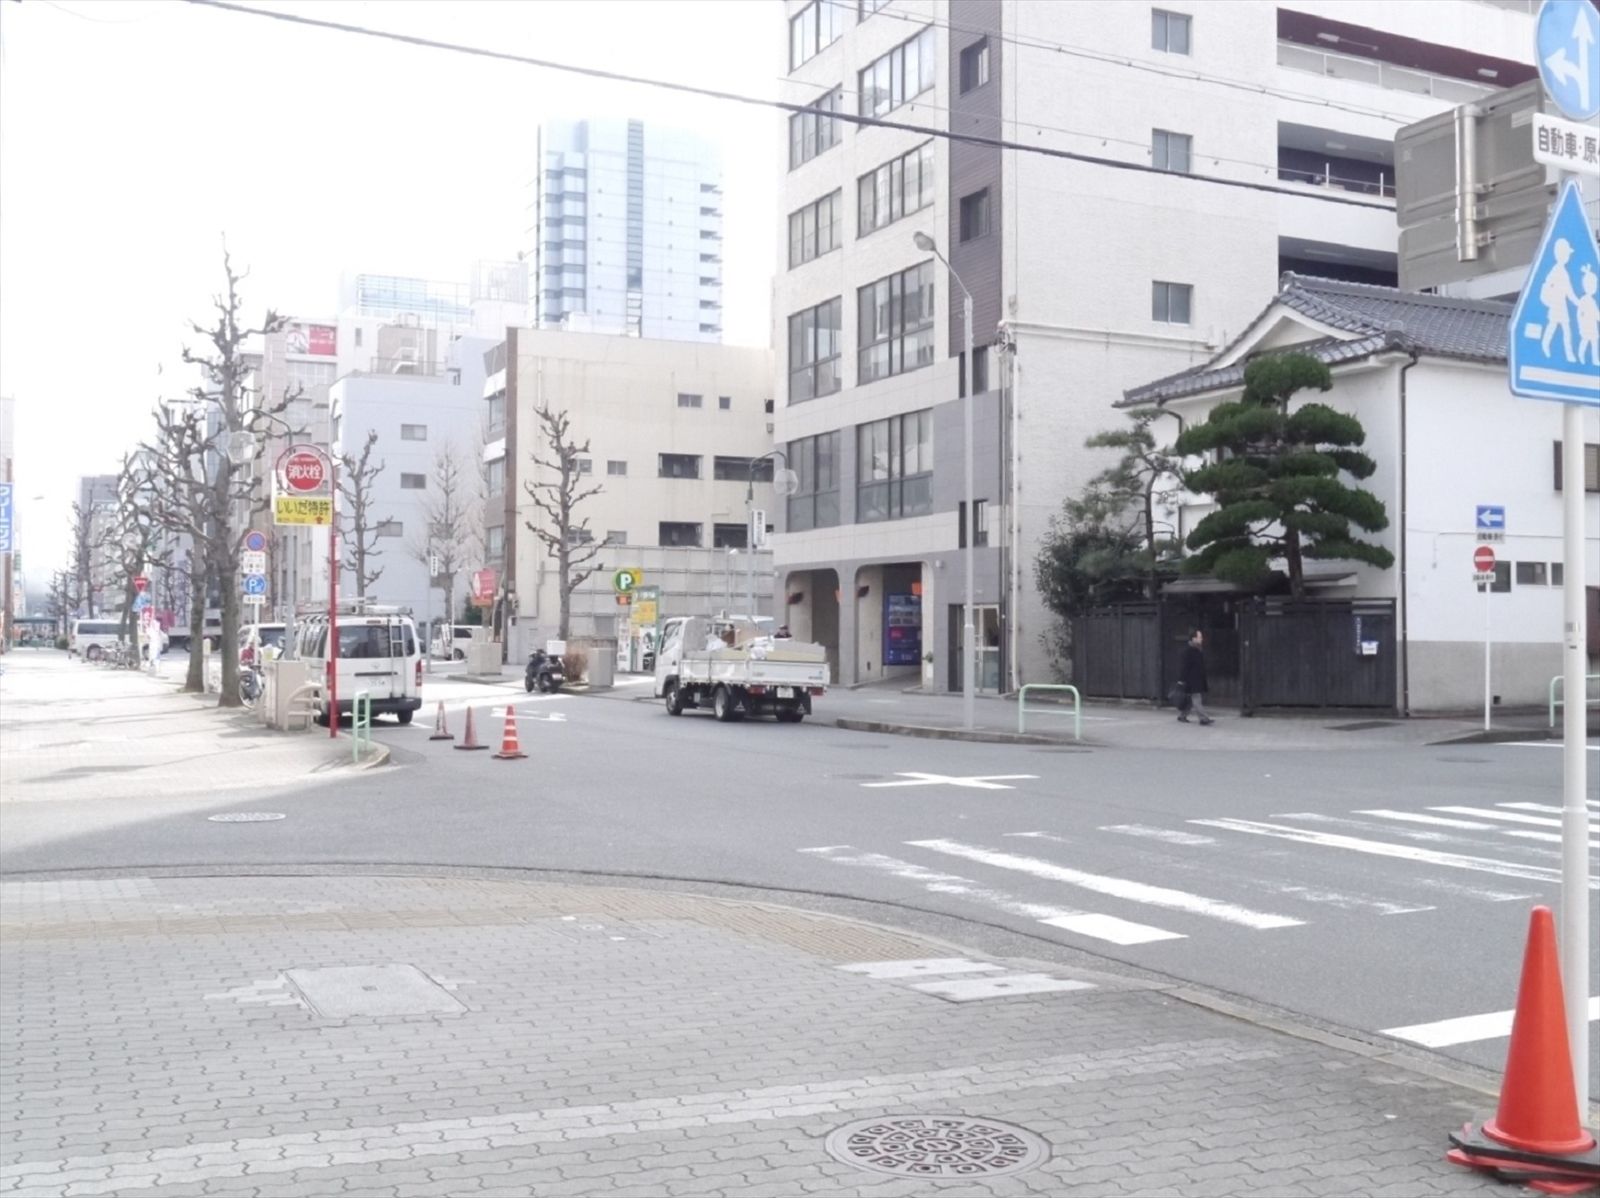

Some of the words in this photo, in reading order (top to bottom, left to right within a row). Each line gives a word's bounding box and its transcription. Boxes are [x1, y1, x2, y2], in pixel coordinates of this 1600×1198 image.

[1538, 125, 1600, 164] 自動車・原
[287, 464, 322, 480] 消火栓
[276, 499, 331, 516] いいだ特許
[620, 573, 632, 590] P
